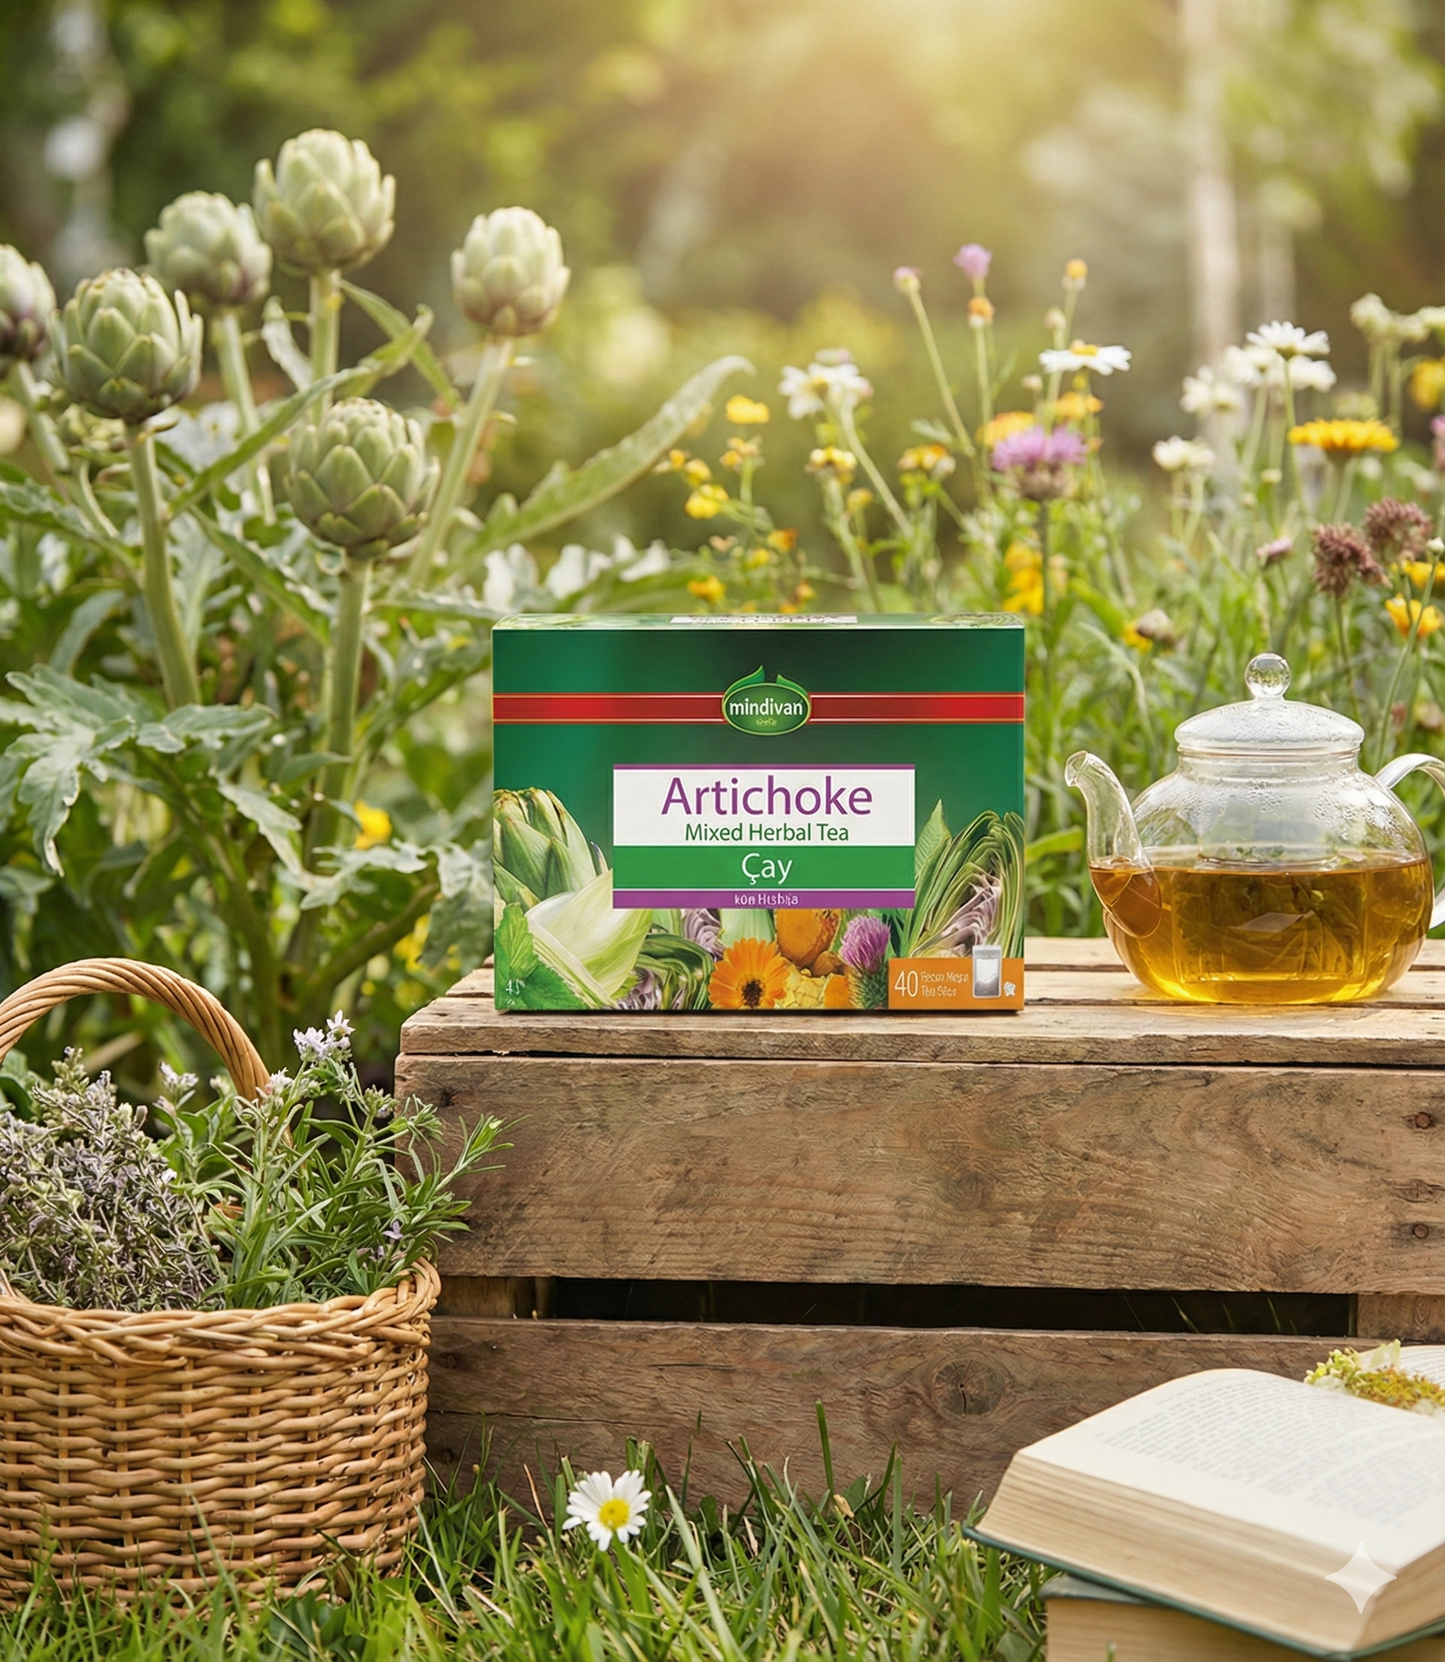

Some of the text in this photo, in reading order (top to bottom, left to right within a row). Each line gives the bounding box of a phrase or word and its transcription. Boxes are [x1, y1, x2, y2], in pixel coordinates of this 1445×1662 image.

[730, 698, 803, 715] mindivan
[662, 775, 873, 815] Artichoke
[685, 822, 849, 841] Mixed Herbal Tea
[742, 853, 793, 885] Çay
[894, 970, 918, 998] 40
